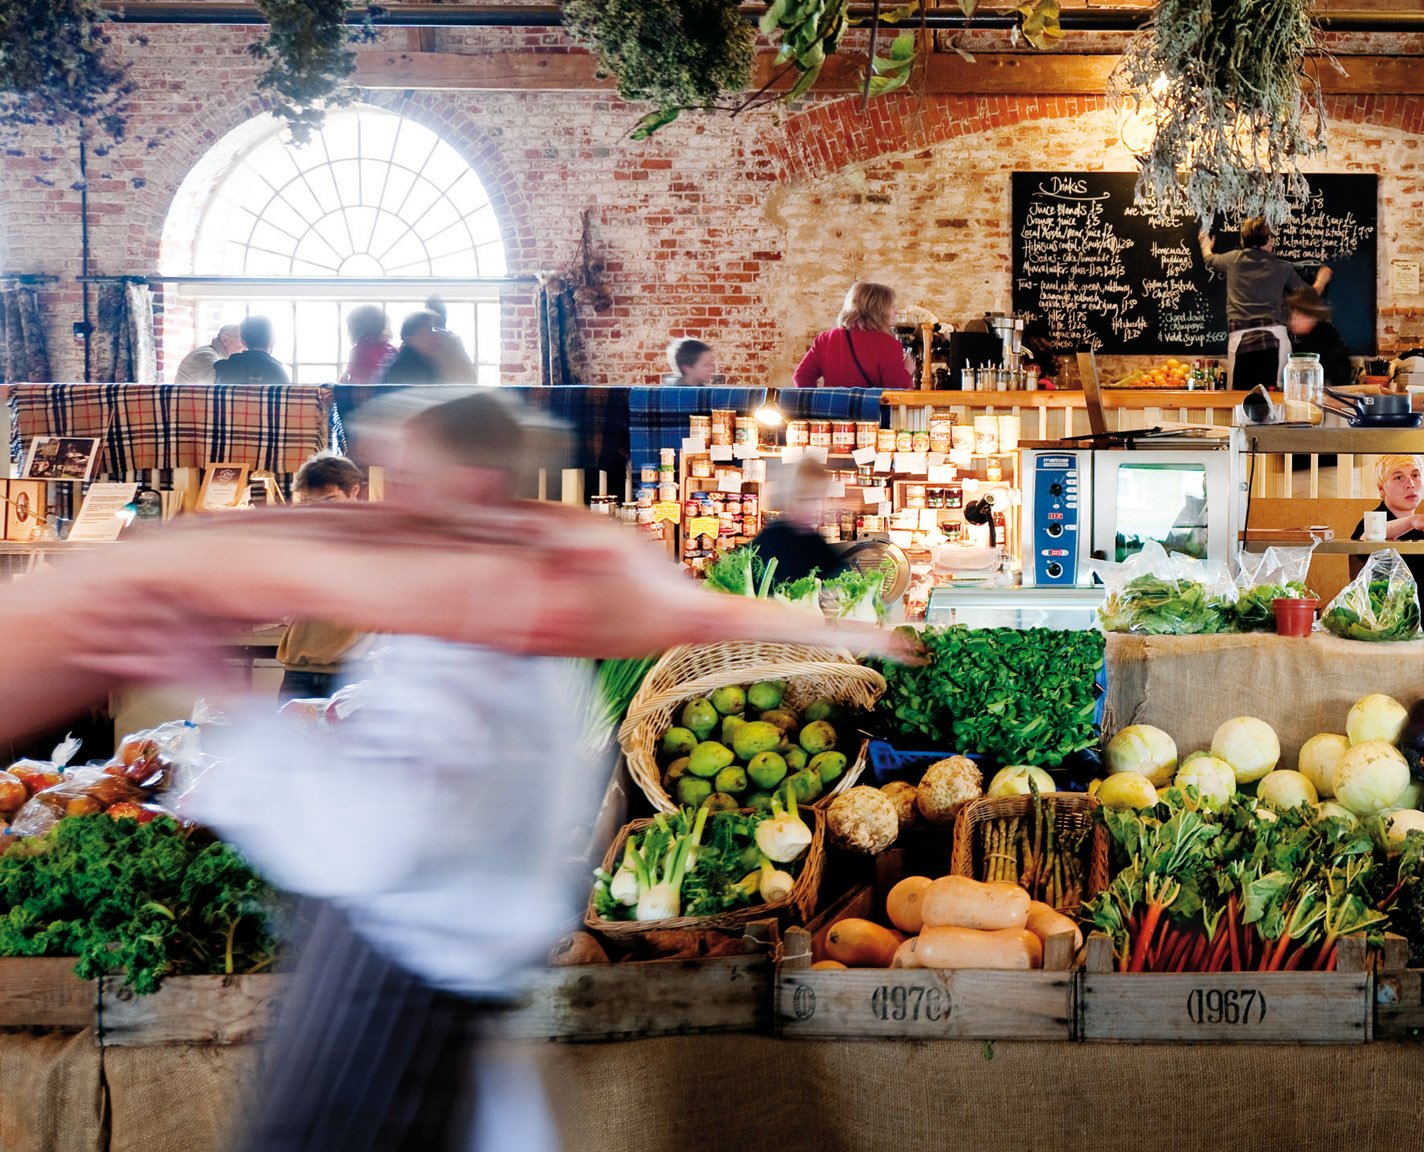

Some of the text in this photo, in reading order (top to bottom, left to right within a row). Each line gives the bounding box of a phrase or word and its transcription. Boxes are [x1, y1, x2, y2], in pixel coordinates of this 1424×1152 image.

[1040, 176, 1087, 195] Drinks
[1029, 202, 1056, 215] Juice
[1026, 214, 1055, 228] Orange
[1150, 239, 1192, 258] Homemade
[1186, 988, 1267, 1025] (1967)
